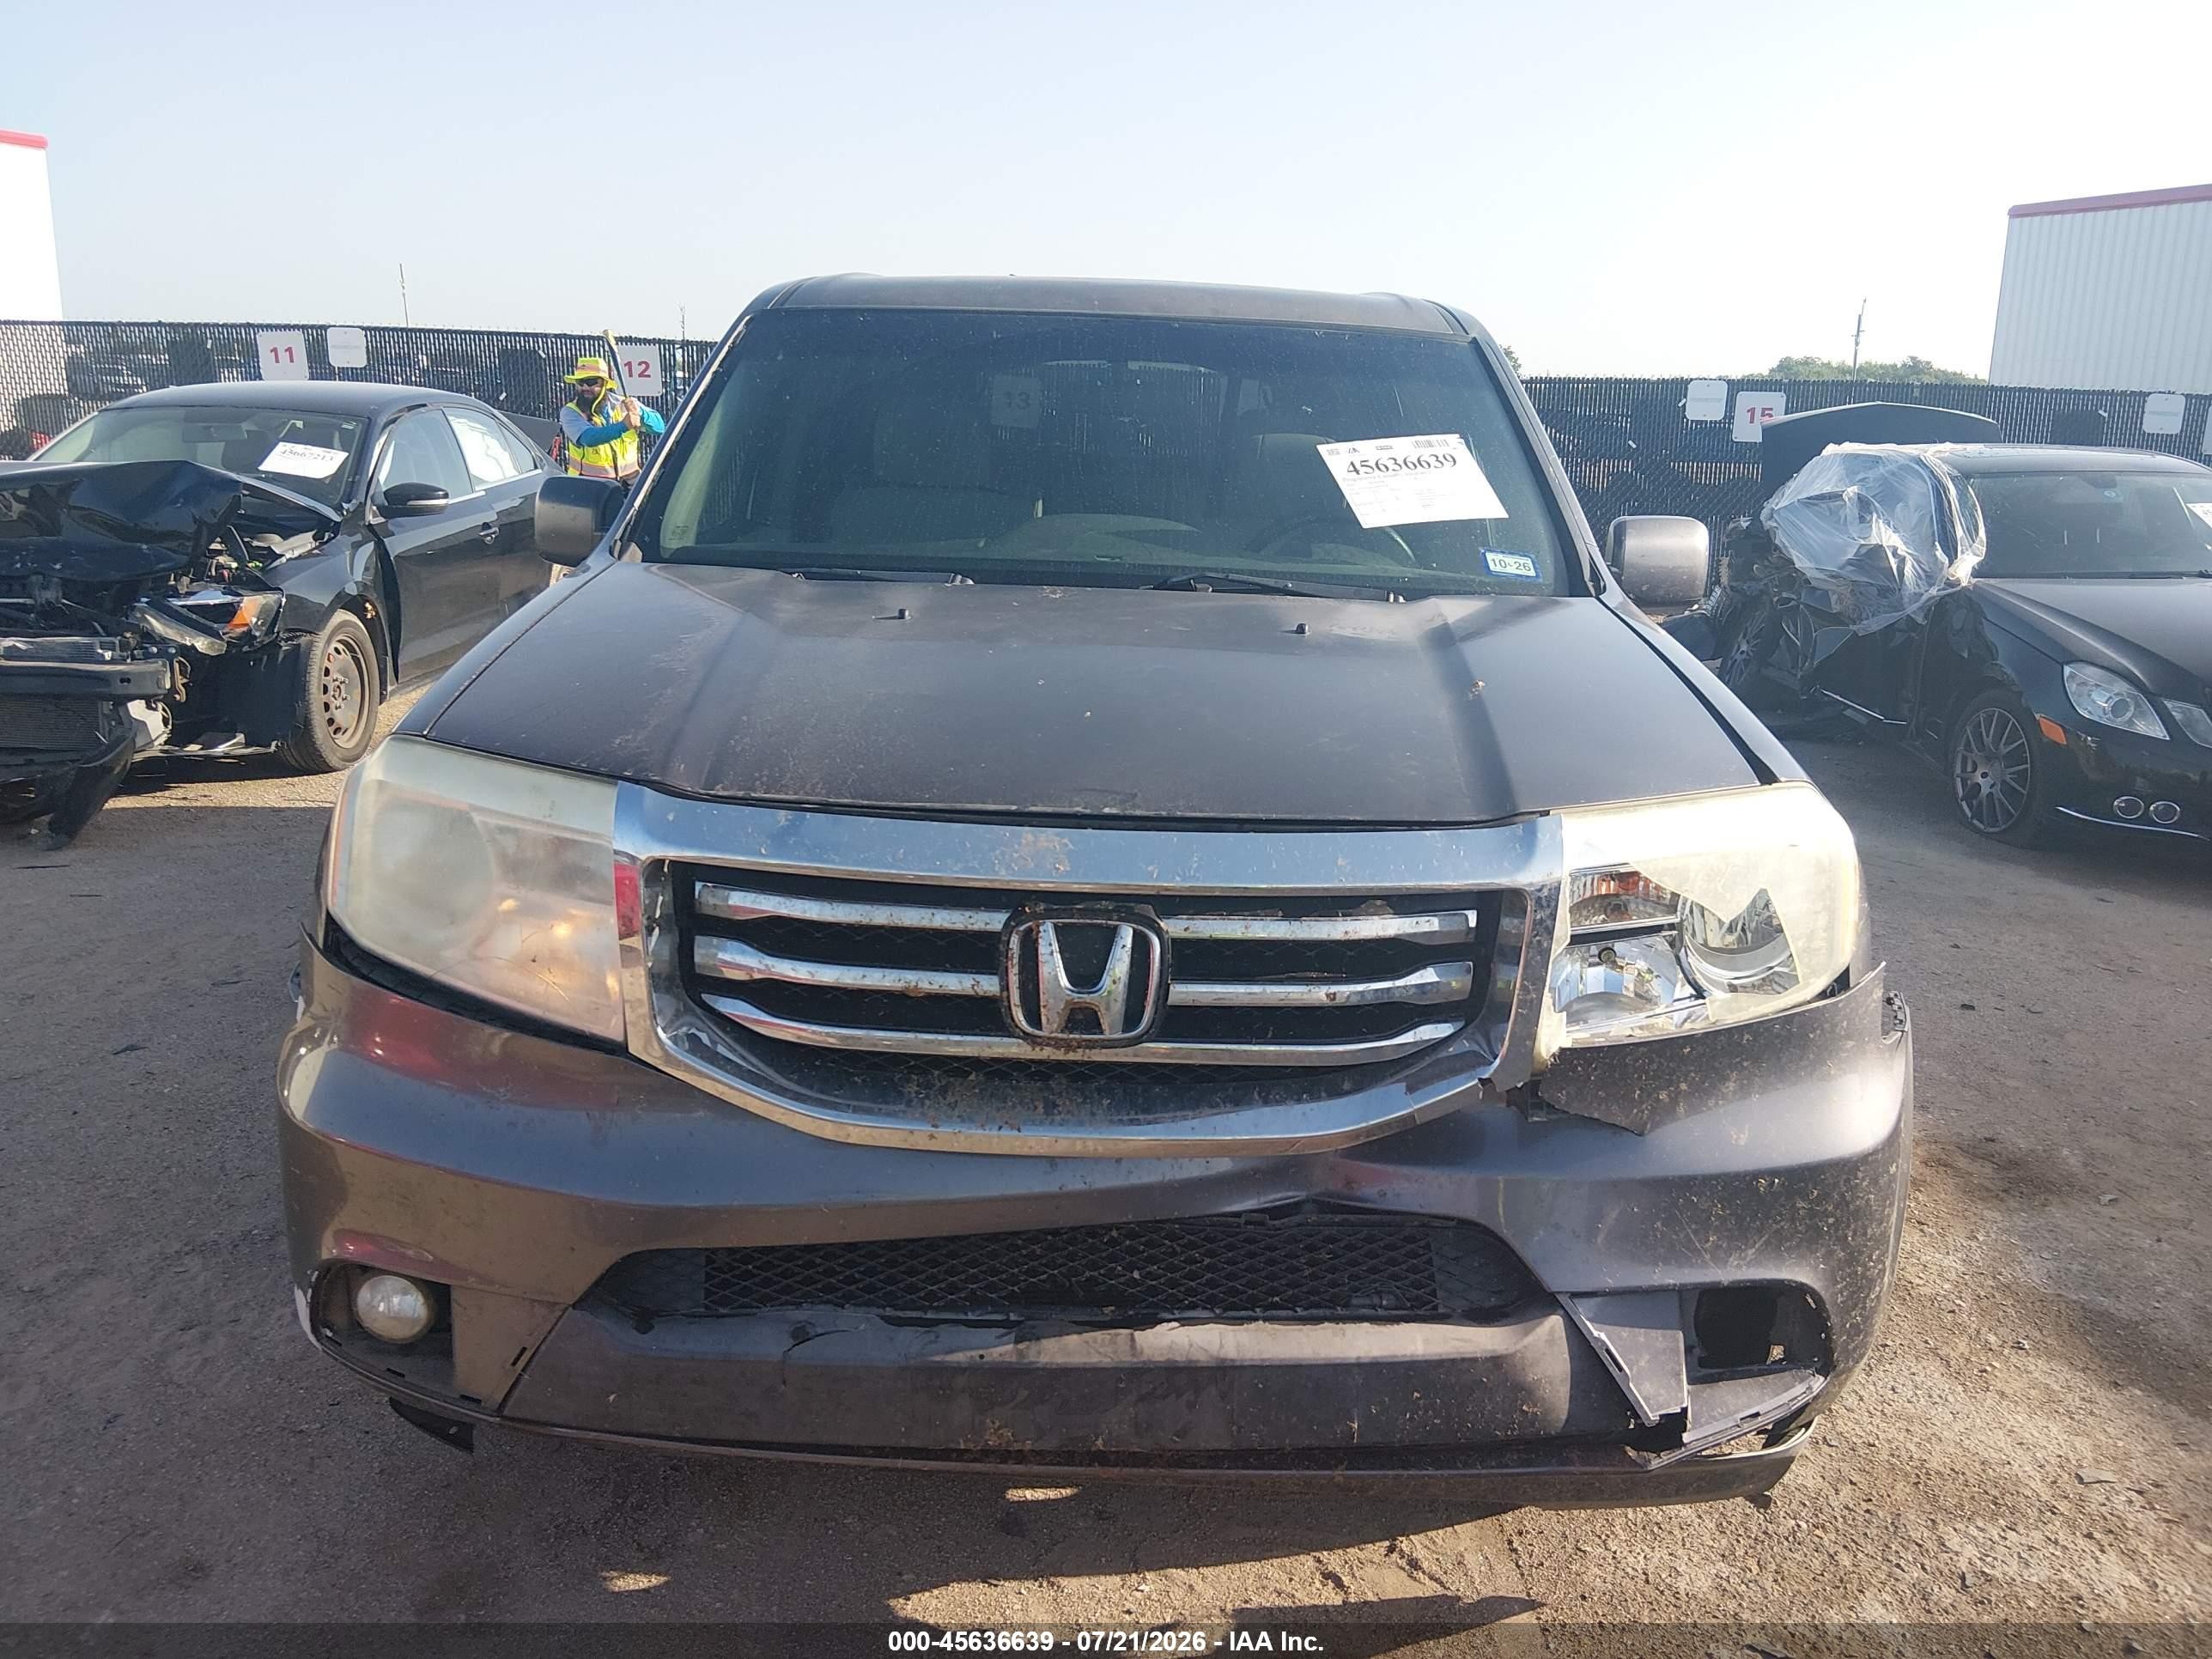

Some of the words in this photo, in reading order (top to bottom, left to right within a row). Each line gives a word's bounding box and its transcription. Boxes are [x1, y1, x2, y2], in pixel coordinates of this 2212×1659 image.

[269, 345, 296, 364] 11
[623, 360, 652, 379] 12
[1002, 391, 1030, 410] 13
[1746, 406, 1774, 424] 15
[1346, 452, 1458, 477] 45636639
